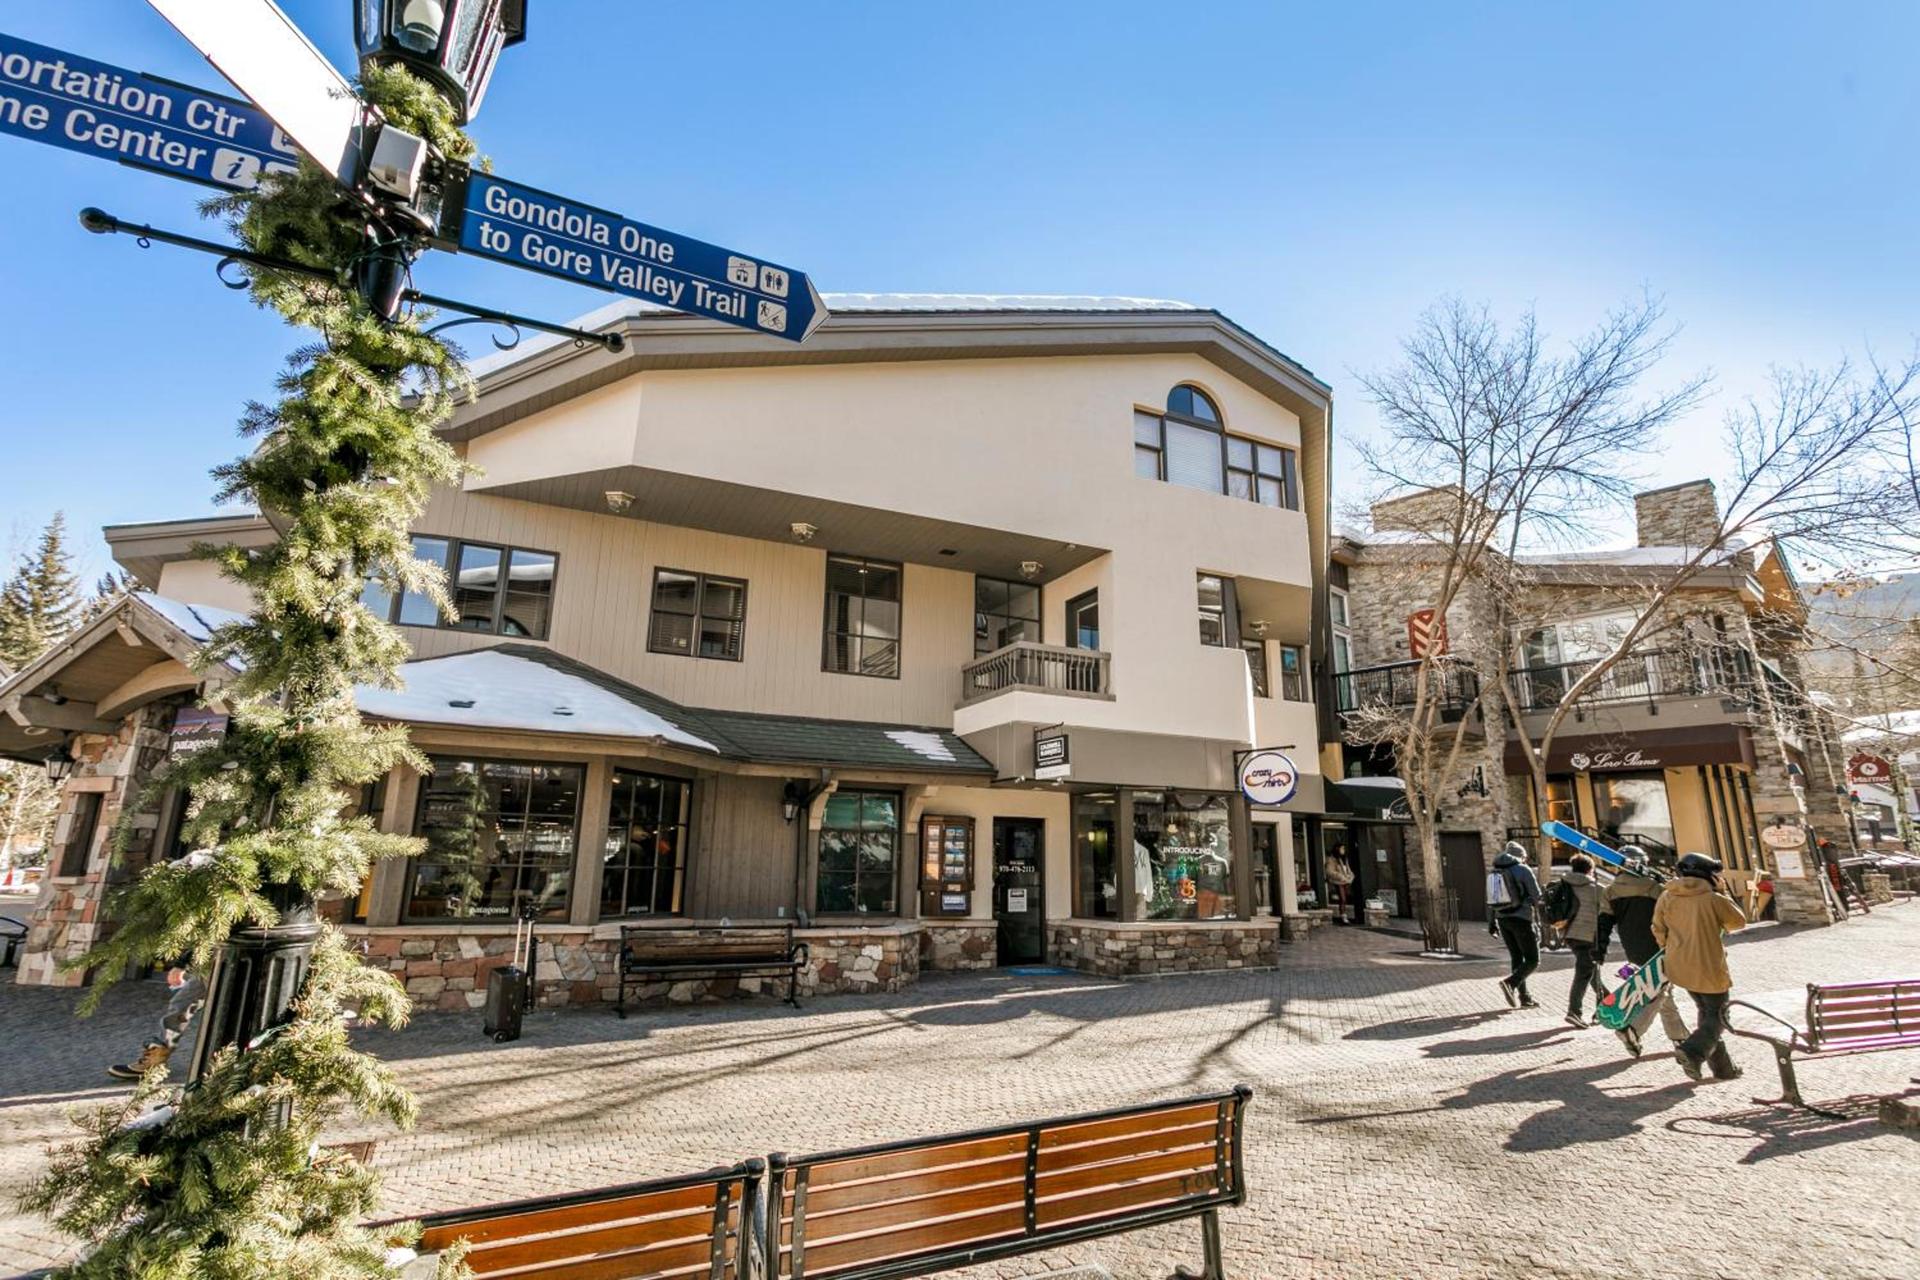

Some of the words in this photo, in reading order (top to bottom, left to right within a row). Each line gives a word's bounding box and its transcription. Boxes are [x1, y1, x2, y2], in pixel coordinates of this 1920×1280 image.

[0, 51, 171, 120] ortation
[186, 98, 246, 139] Ctr
[65, 107, 207, 171] Center
[485, 185, 610, 247] Gondola
[620, 225, 675, 264] One
[479, 221, 511, 253] to
[521, 233, 593, 276] Gore
[600, 254, 685, 306] Valley
[691, 280, 747, 319] Trail
[1590, 752, 1622, 769] Loro
[1623, 749, 1661, 767] Piana
[1162, 846, 1213, 855] INTRODUCING
